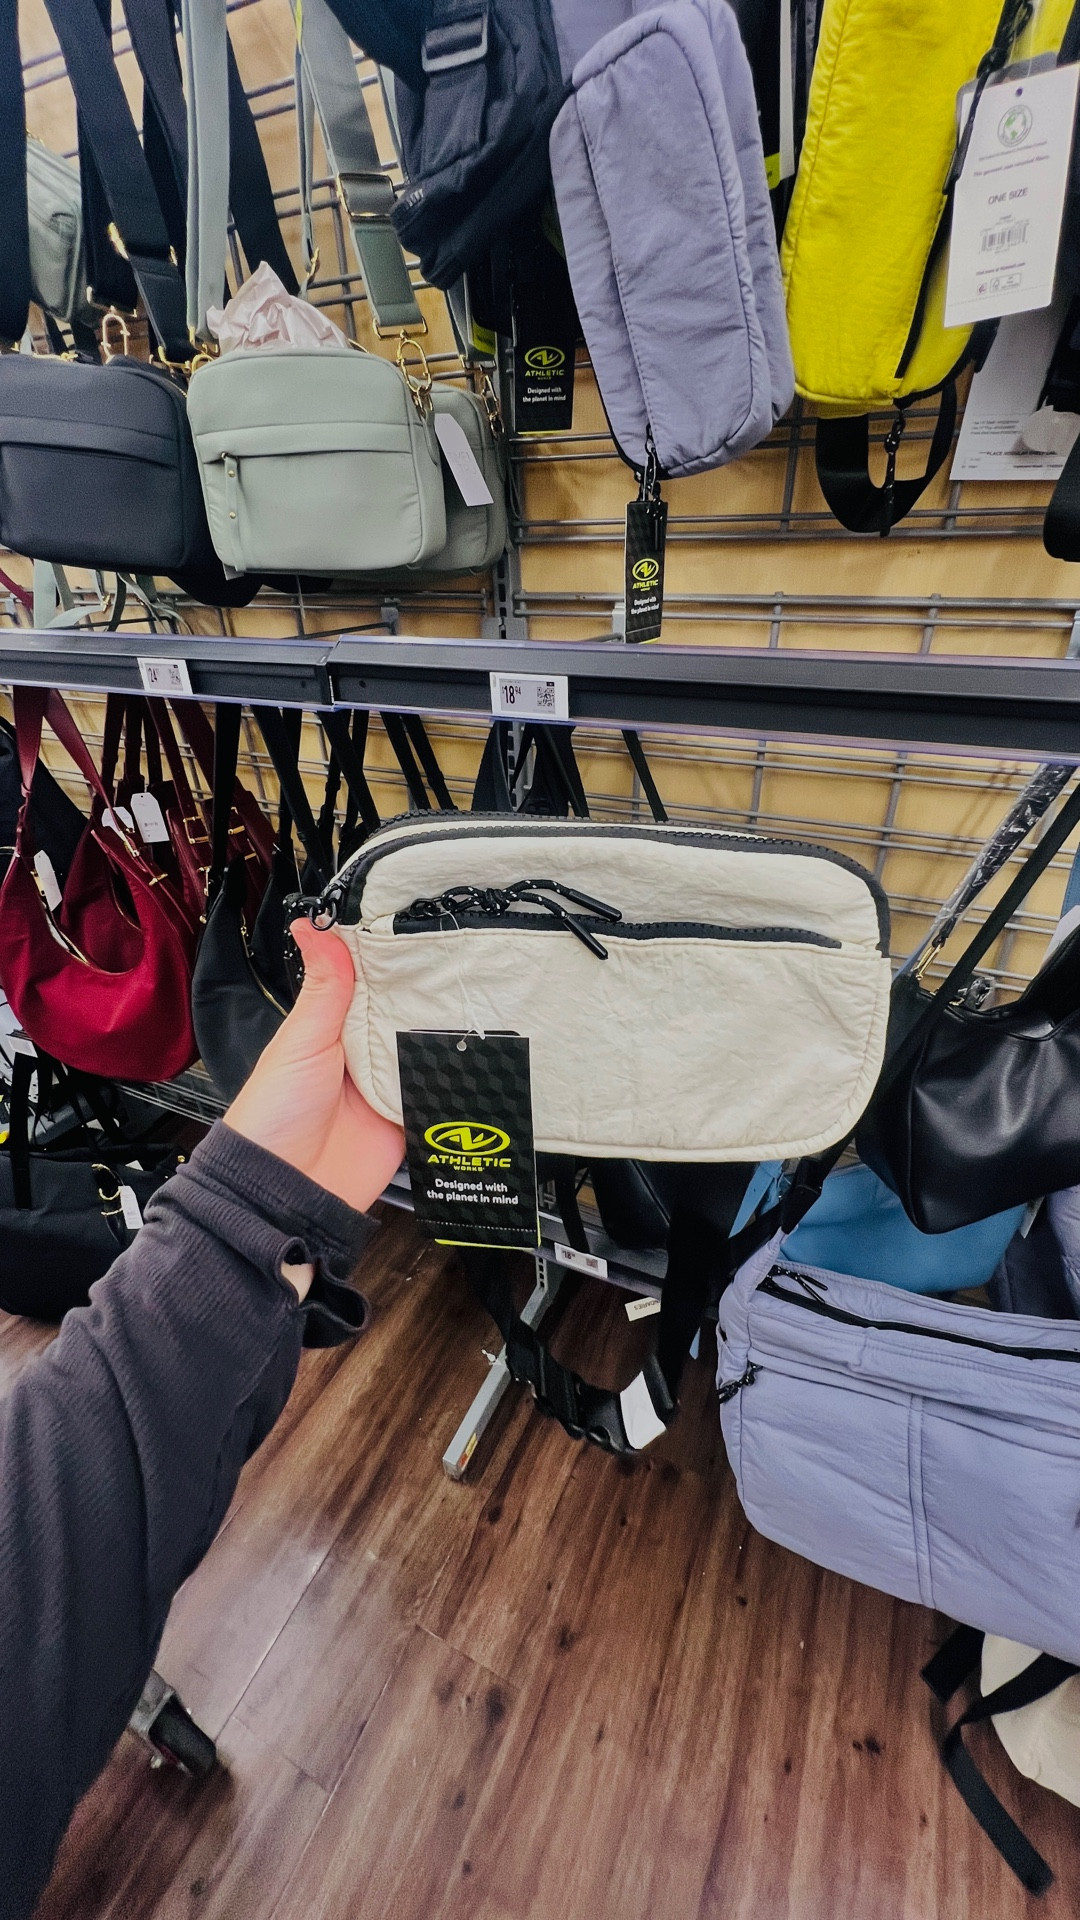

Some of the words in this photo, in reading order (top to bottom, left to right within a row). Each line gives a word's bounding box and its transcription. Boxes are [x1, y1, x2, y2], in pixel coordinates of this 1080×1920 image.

[988, 192, 1007, 205] ONE
[1008, 187, 1028, 200] SIZE
[528, 387, 550, 395] Designed
[427, 1154, 511, 1168] ATHLETIC
[434, 1178, 483, 1192] Designed
[485, 1182, 508, 1193] with
[426, 1189, 444, 1199] the
[445, 1191, 479, 1202] planet
[480, 1193, 491, 1203] in
[492, 1194, 519, 1205] mind
